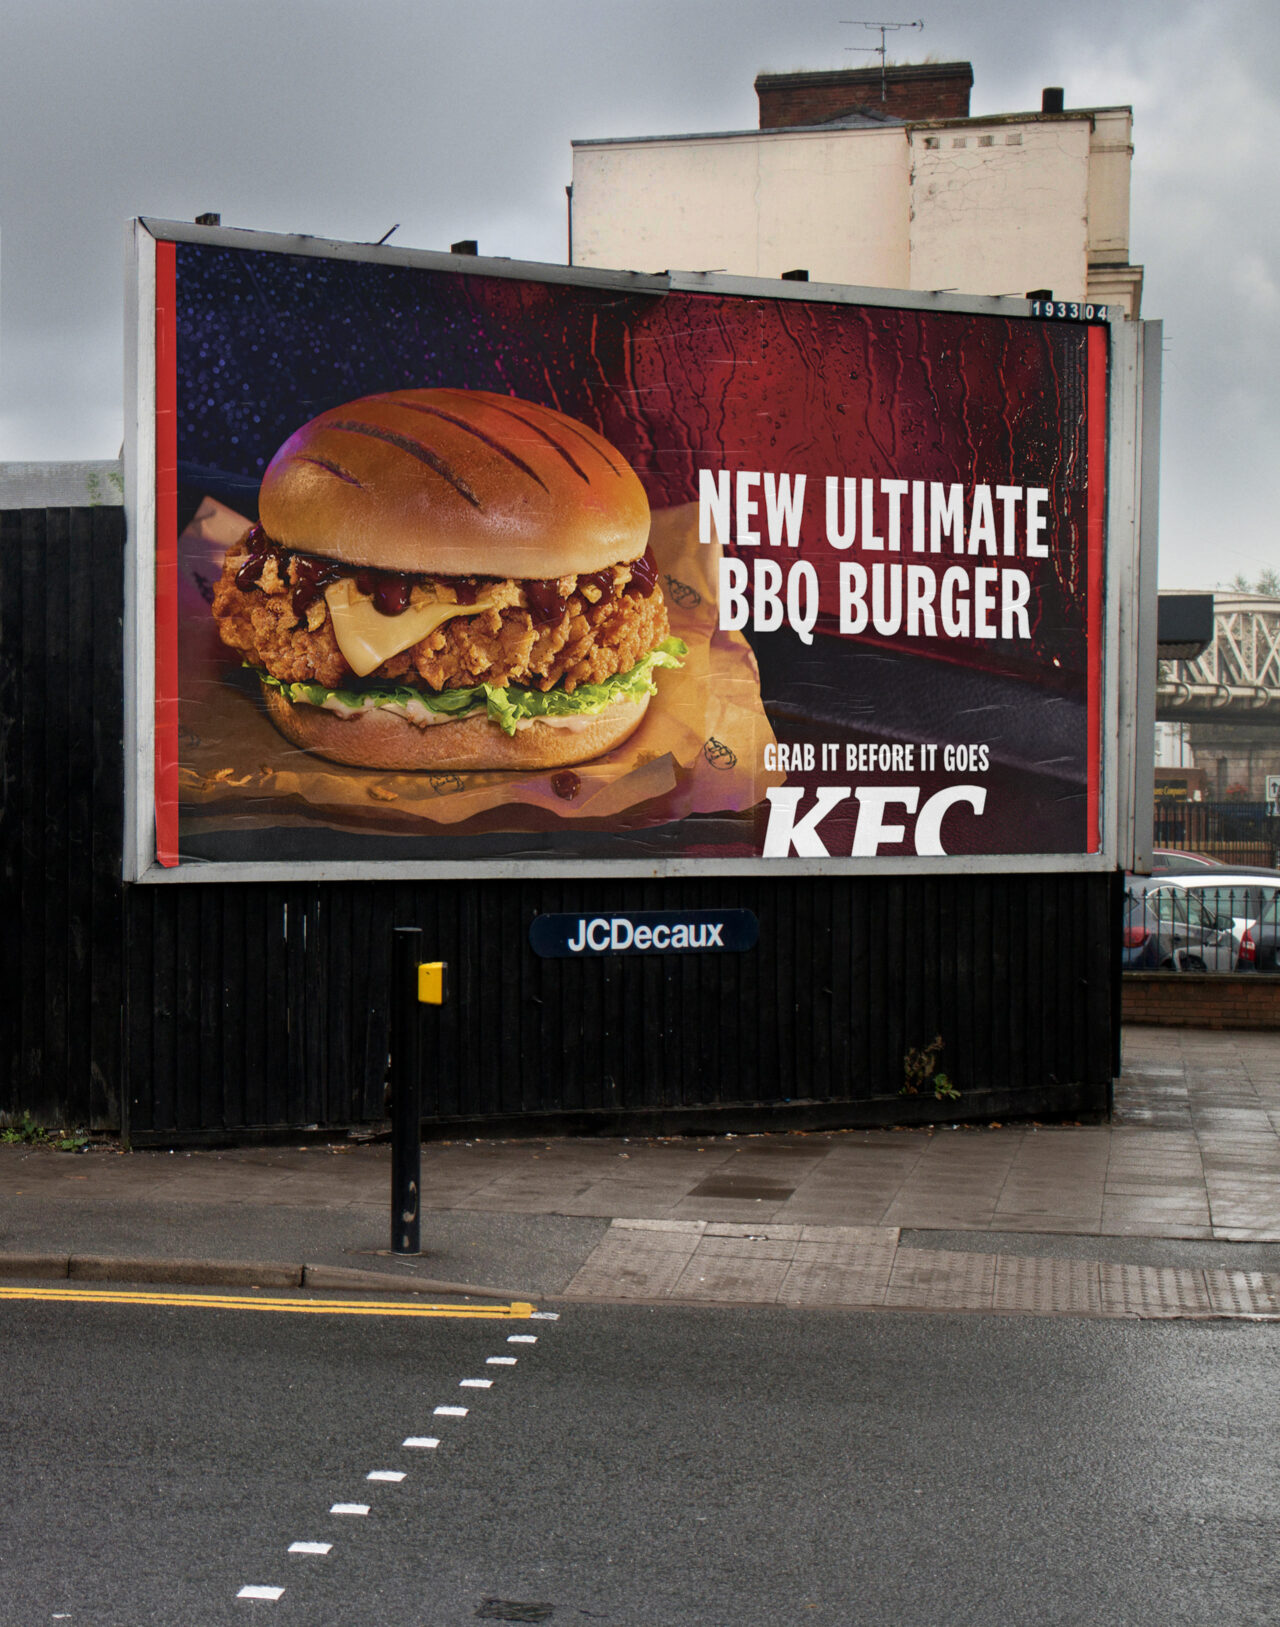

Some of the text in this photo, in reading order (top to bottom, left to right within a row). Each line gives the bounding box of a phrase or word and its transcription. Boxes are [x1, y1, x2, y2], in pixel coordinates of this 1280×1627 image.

[698, 468, 1049, 558] NEW ULTIMATE
[719, 557, 1032, 646] BBQ BURGER
[763, 743, 990, 772] GRAB IT BEFORE IT GOES
[762, 784, 987, 858] KFC
[568, 918, 724, 952] JCDecaux
